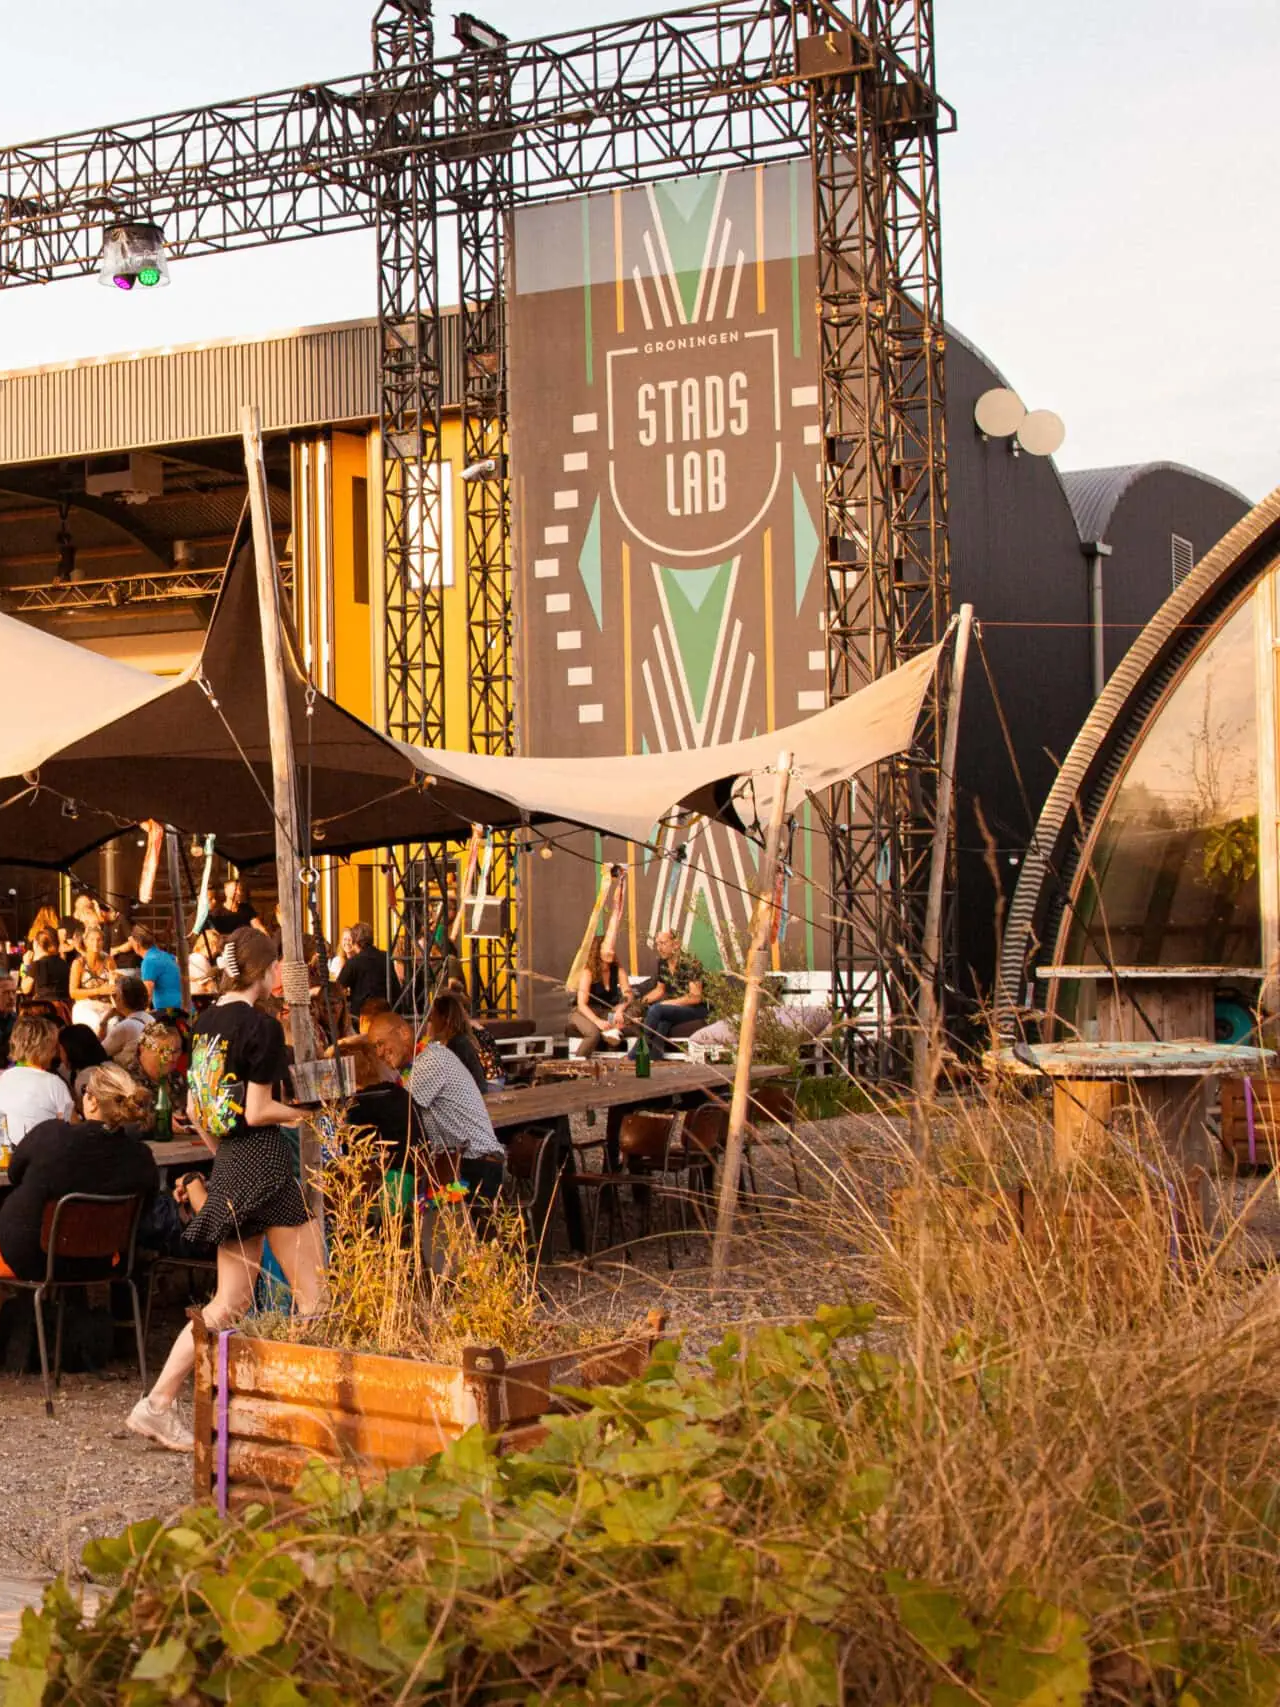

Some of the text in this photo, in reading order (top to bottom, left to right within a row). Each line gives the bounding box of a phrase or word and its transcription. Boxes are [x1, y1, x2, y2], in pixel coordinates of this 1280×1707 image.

[643, 331, 739, 354] GRONINGEN
[638, 371, 748, 447] STADS
[666, 448, 727, 516] LAB
